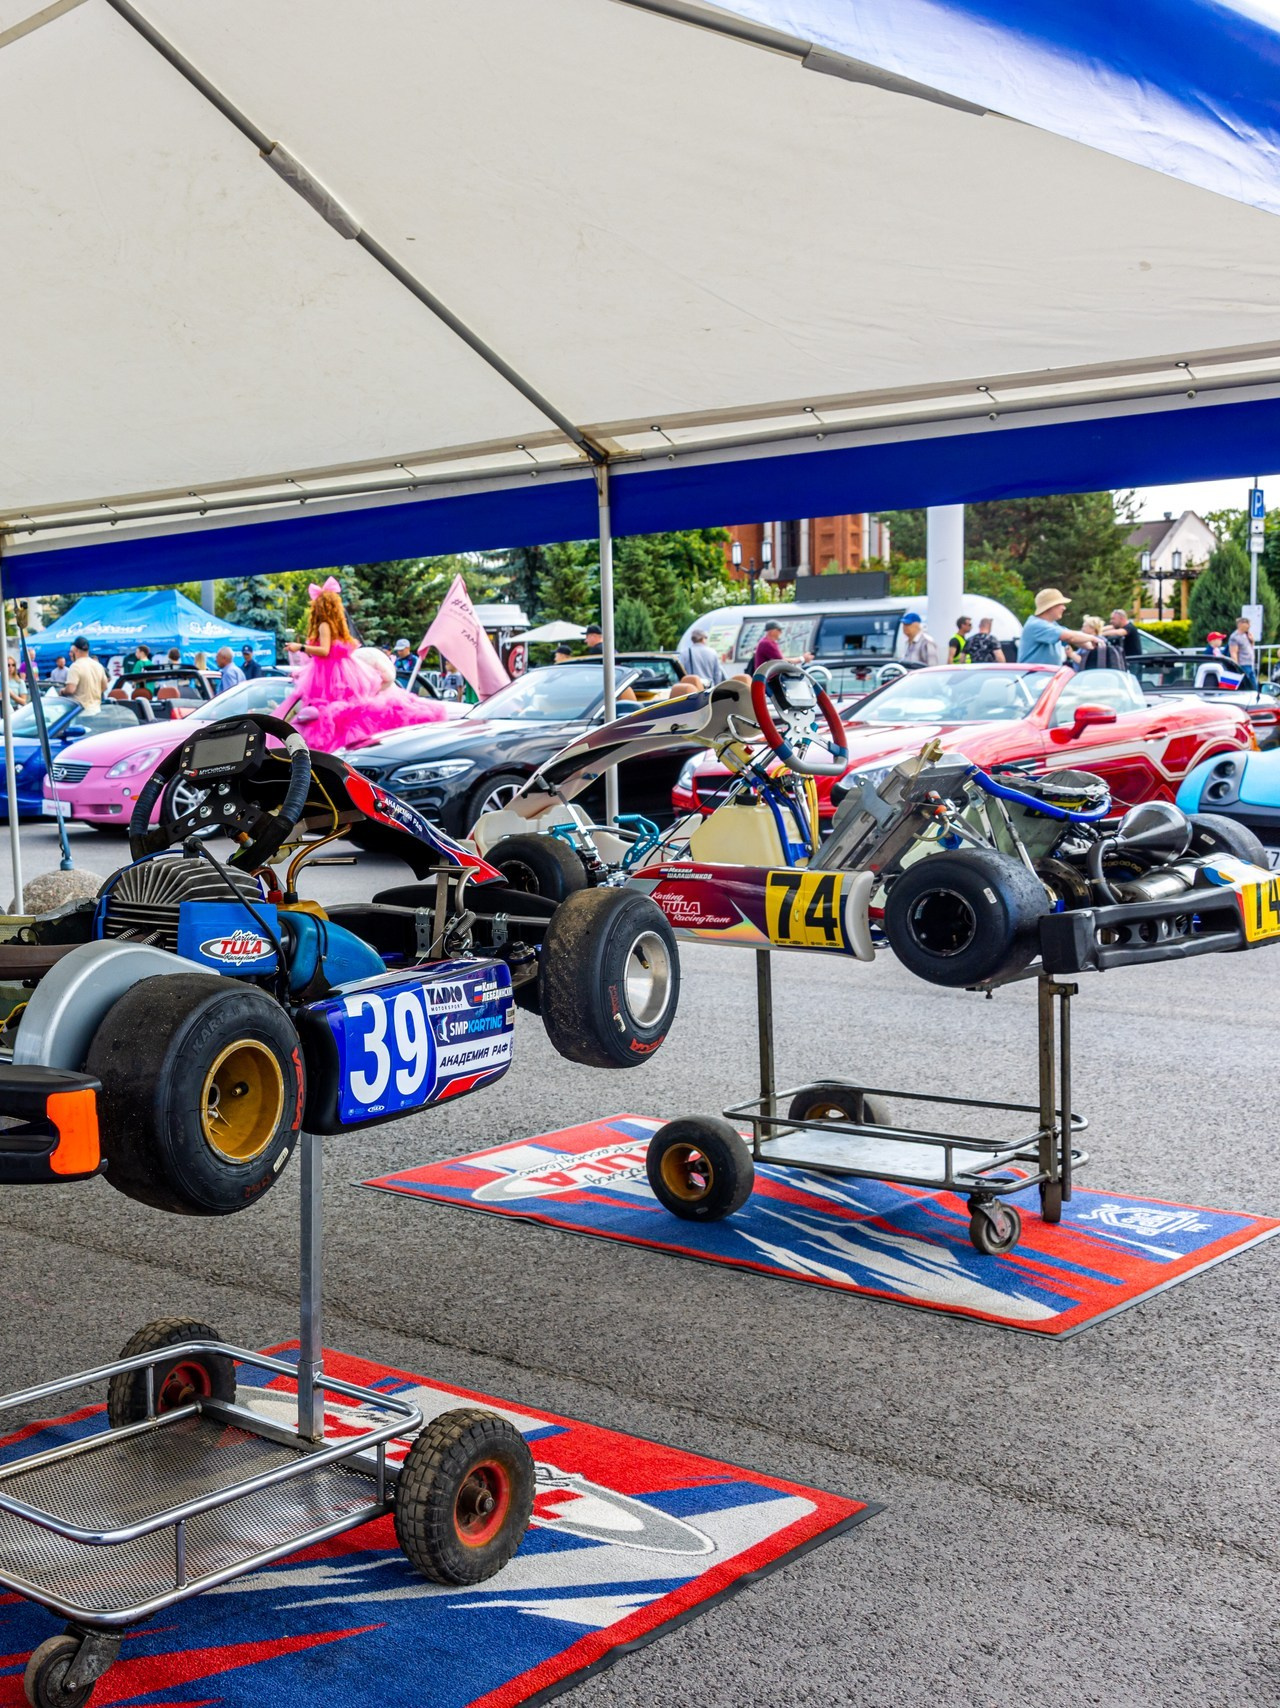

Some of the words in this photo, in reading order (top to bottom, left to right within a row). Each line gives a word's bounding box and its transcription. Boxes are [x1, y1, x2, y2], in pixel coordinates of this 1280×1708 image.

[1254, 491, 1263, 516] P
[651, 892, 684, 902] Karting
[770, 873, 838, 941] 74
[662, 901, 701, 915] TULA
[673, 914, 706, 924] Racing
[705, 915, 731, 923] Team
[221, 941, 262, 955] TULA
[426, 985, 463, 1006] YADRO
[482, 981, 498, 992] Клим
[431, 1003, 463, 1012] MOTORSPORT
[343, 991, 429, 1104] 39
[439, 1047, 490, 1068] АКАДЕМИЯ
[492, 1042, 508, 1057] РАФ
[291, 1047, 304, 1131] VEGA
[525, 1147, 648, 1188] ULA
[583, 1163, 647, 1185] rting
